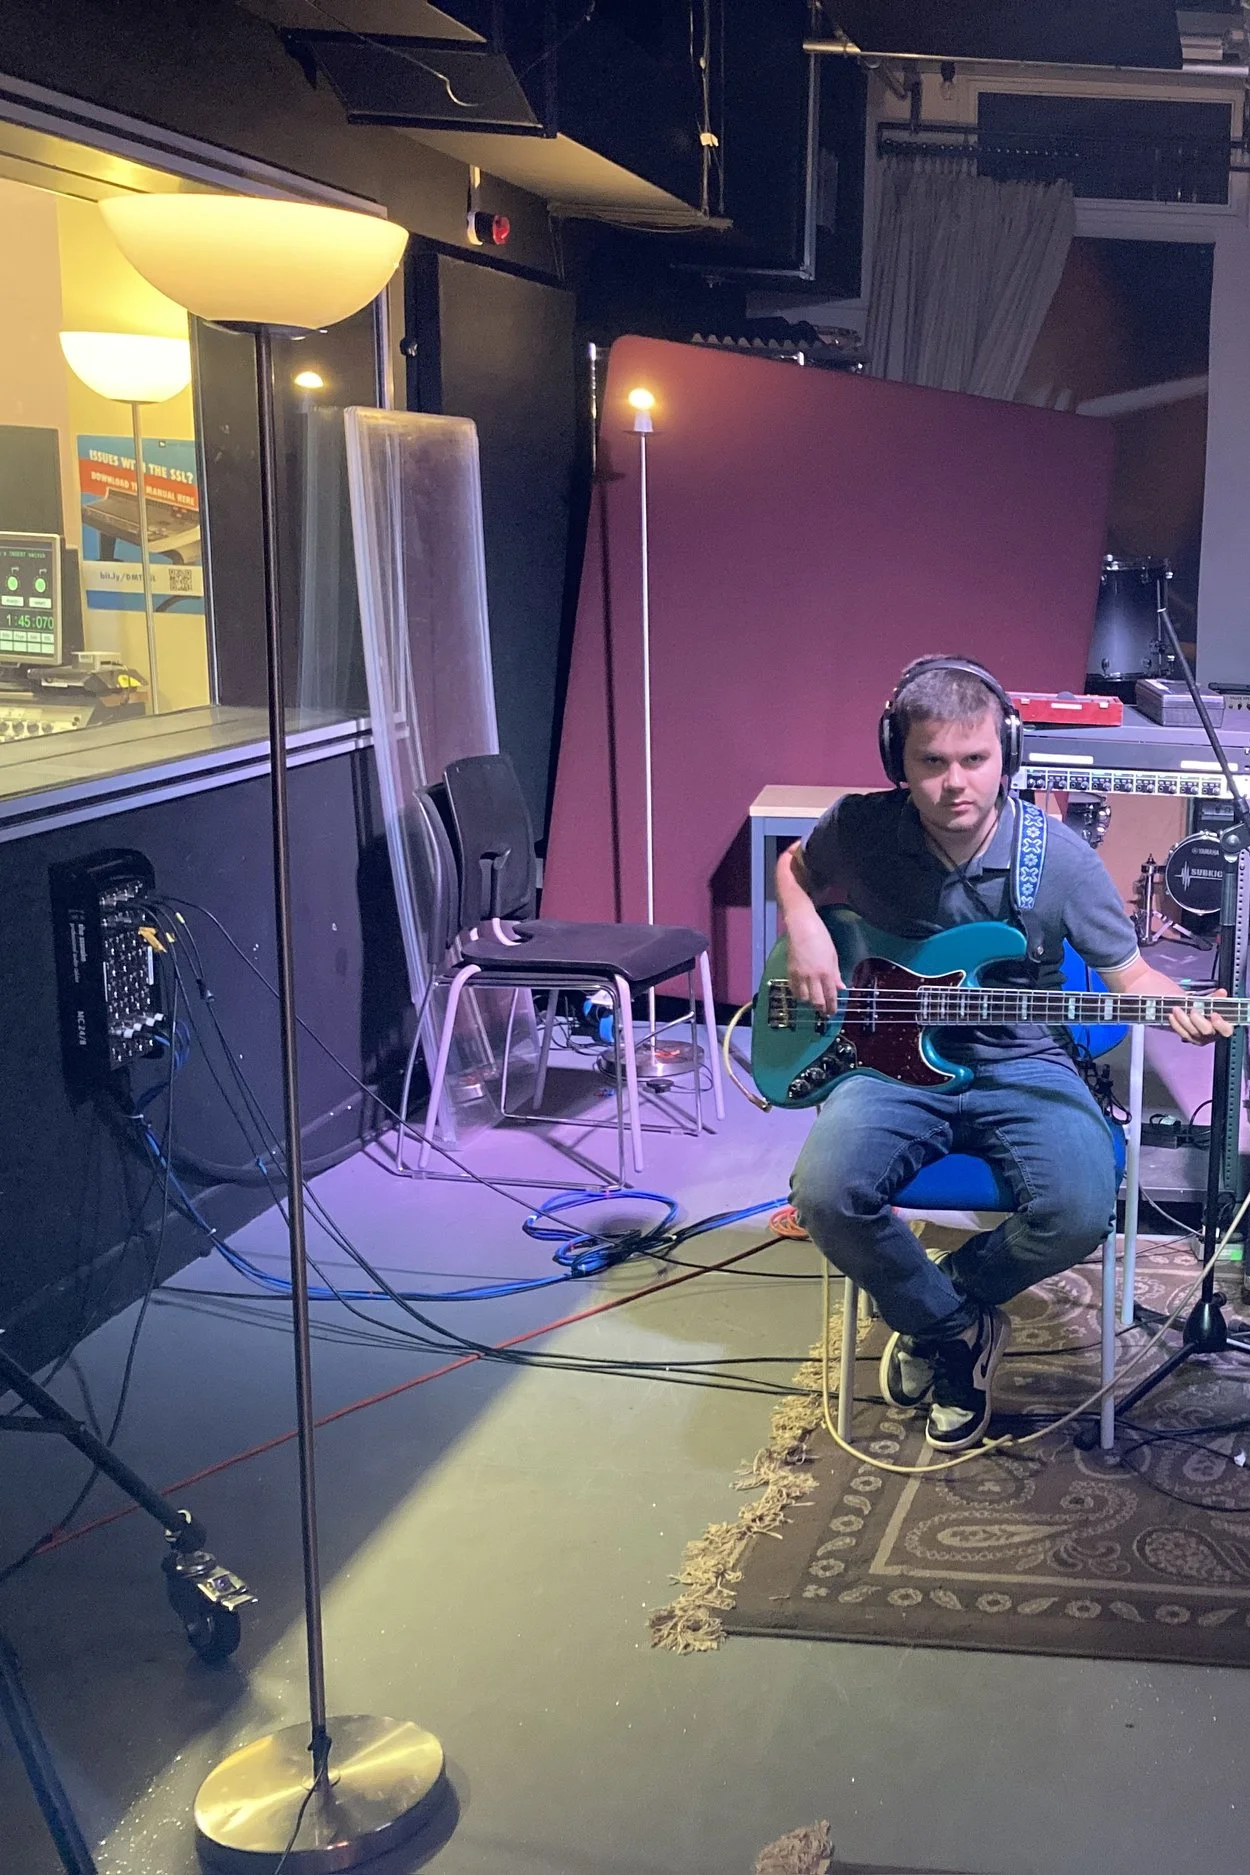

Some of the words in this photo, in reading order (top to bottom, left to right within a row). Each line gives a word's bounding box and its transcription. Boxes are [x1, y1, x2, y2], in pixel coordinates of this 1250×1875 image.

[89, 449, 119, 466] ISSUES
[148, 464, 168, 478] THE
[170, 468, 194, 484] SSL?
[91, 471, 129, 488] DOWNLOAD
[146, 486, 175, 500] MANUAL
[177, 494, 195, 506] HERE
[1191, 869, 1223, 877] SUBKIC
